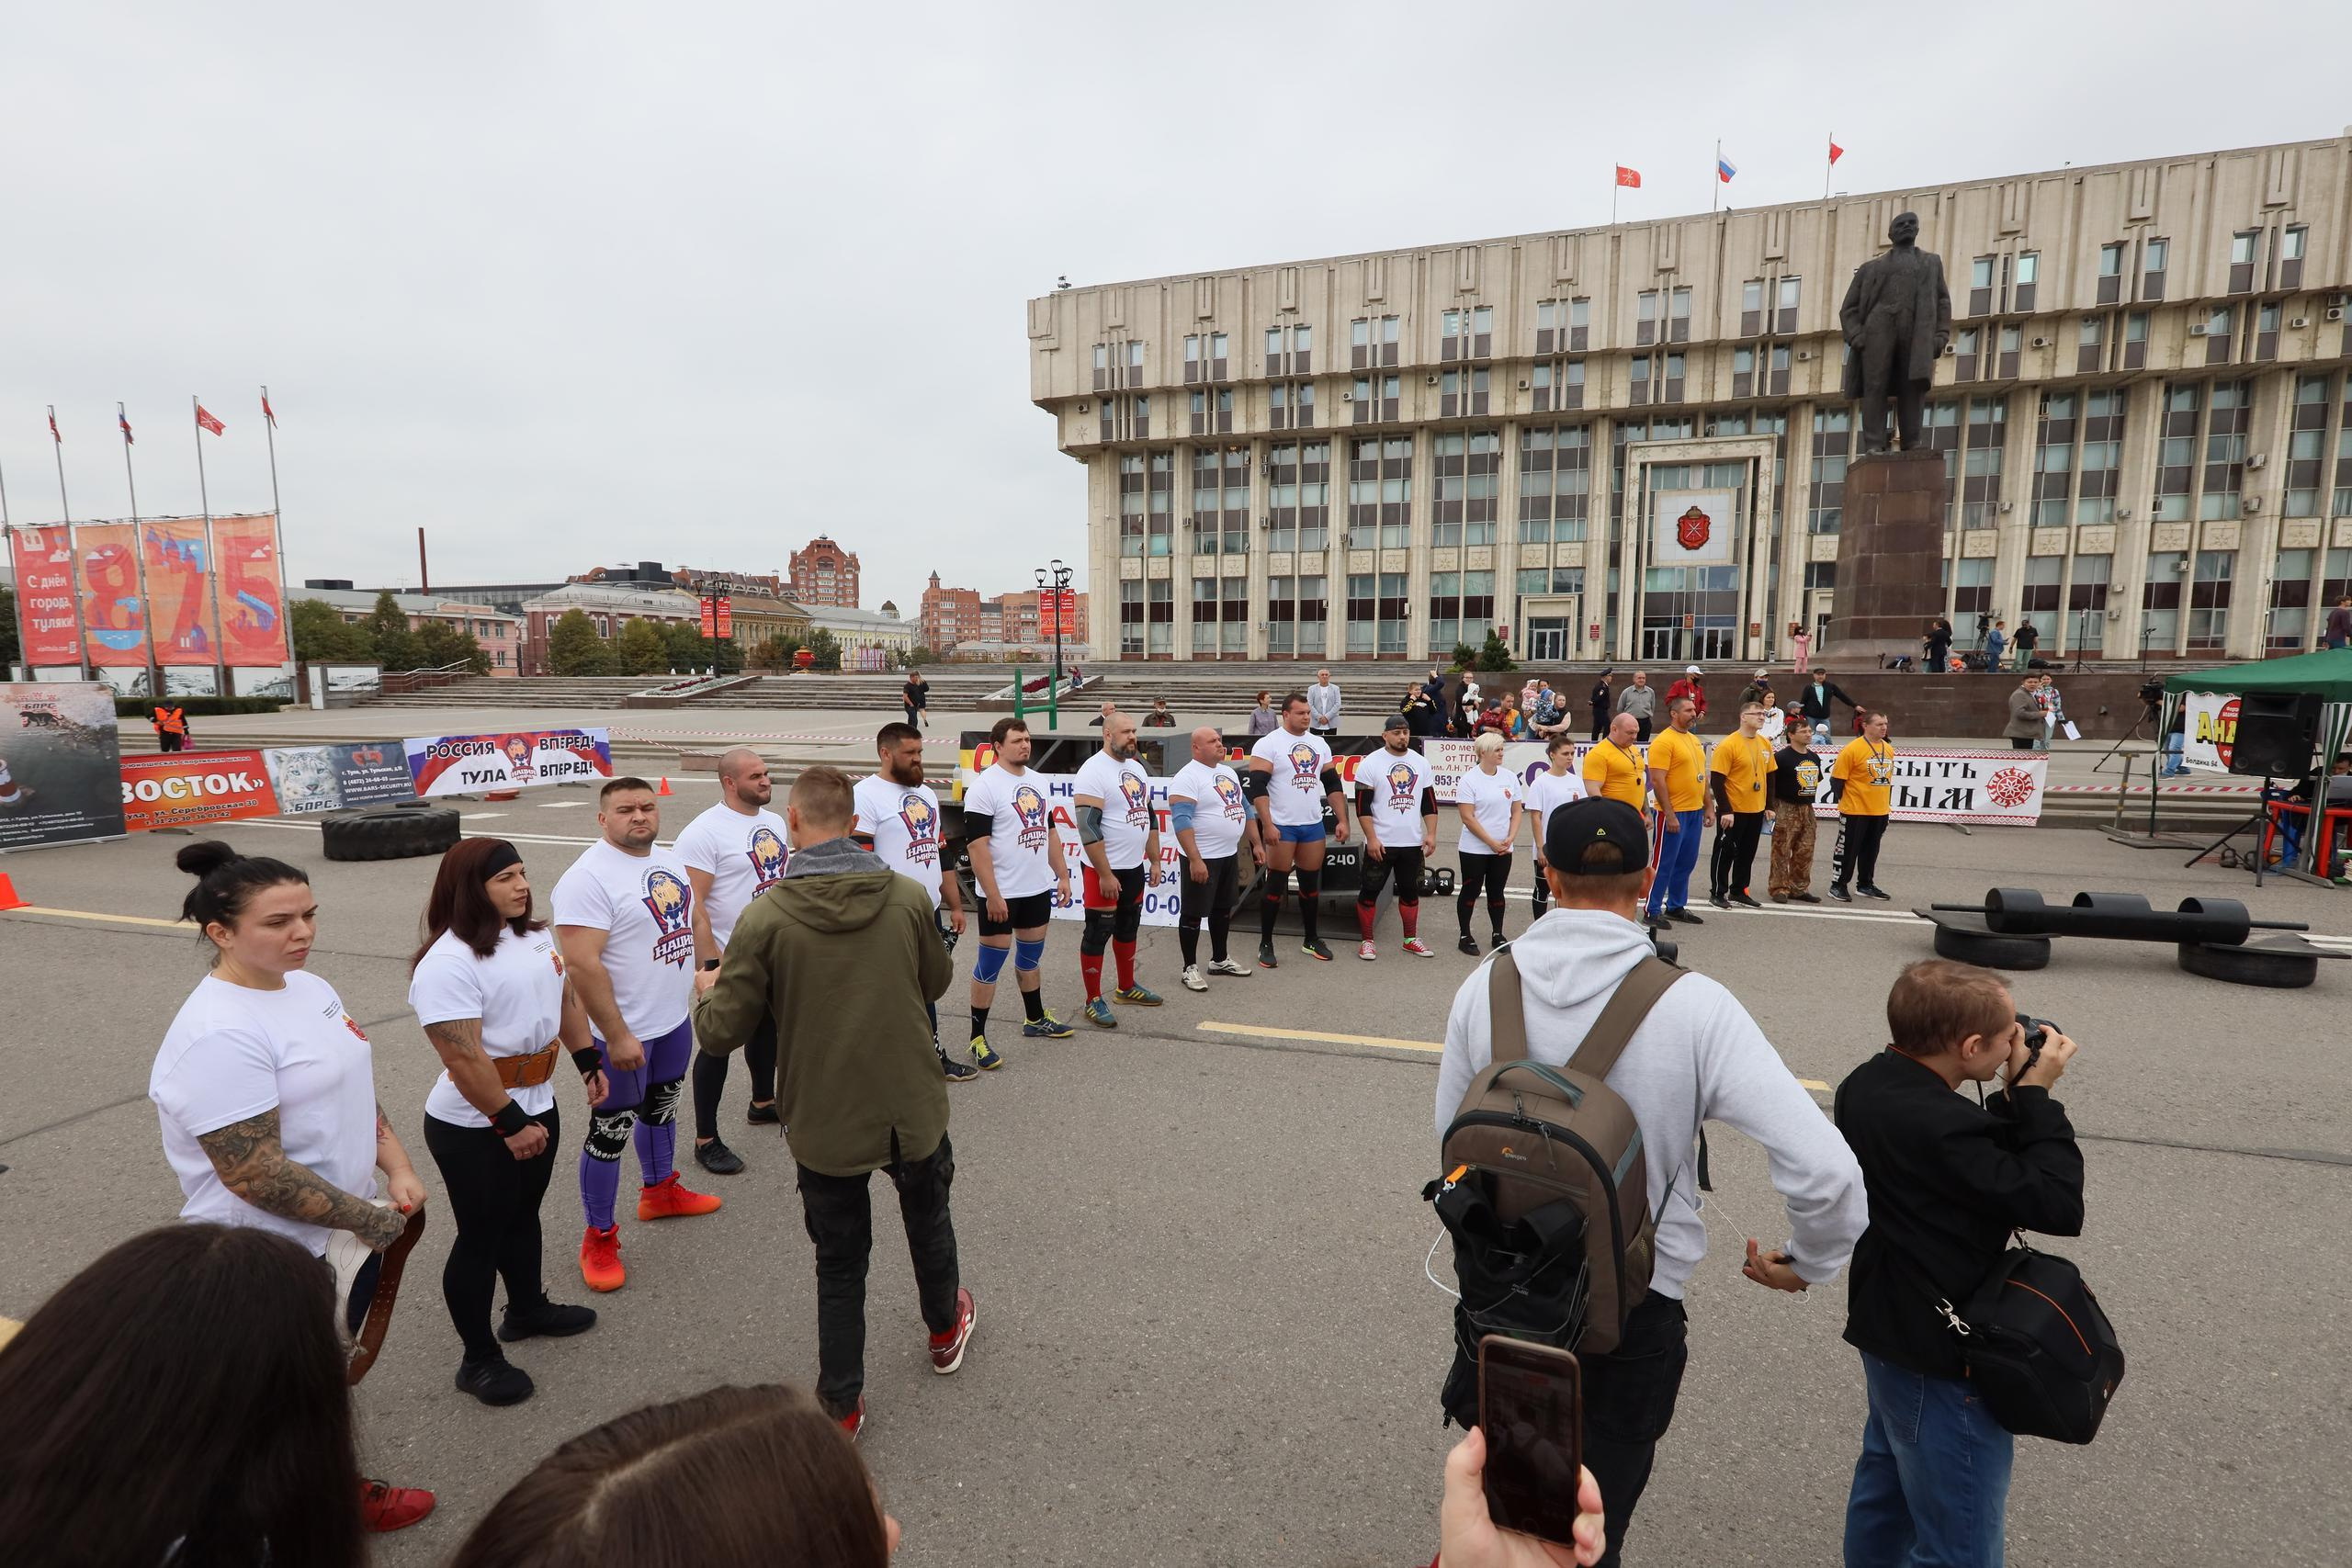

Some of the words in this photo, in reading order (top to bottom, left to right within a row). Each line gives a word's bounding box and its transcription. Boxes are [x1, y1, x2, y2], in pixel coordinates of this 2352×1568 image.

[27, 575, 38, 589] С
[40, 572, 68, 590] днём
[29, 596, 73, 612] города,
[31, 614, 74, 633] туляки!
[425, 741, 495, 760] РОССИЯ
[538, 734, 595, 750] ВПЕРЕД!
[1440, 743, 1456, 752] 300
[1459, 753, 1476, 762] ТГП
[460, 768, 507, 785] ТУЛА
[539, 761, 593, 777] ВПЕРЕД!
[1434, 774, 1462, 786] 953-9
[171, 802, 243, 815] Серебровская
[1326, 853, 1356, 866] 240
